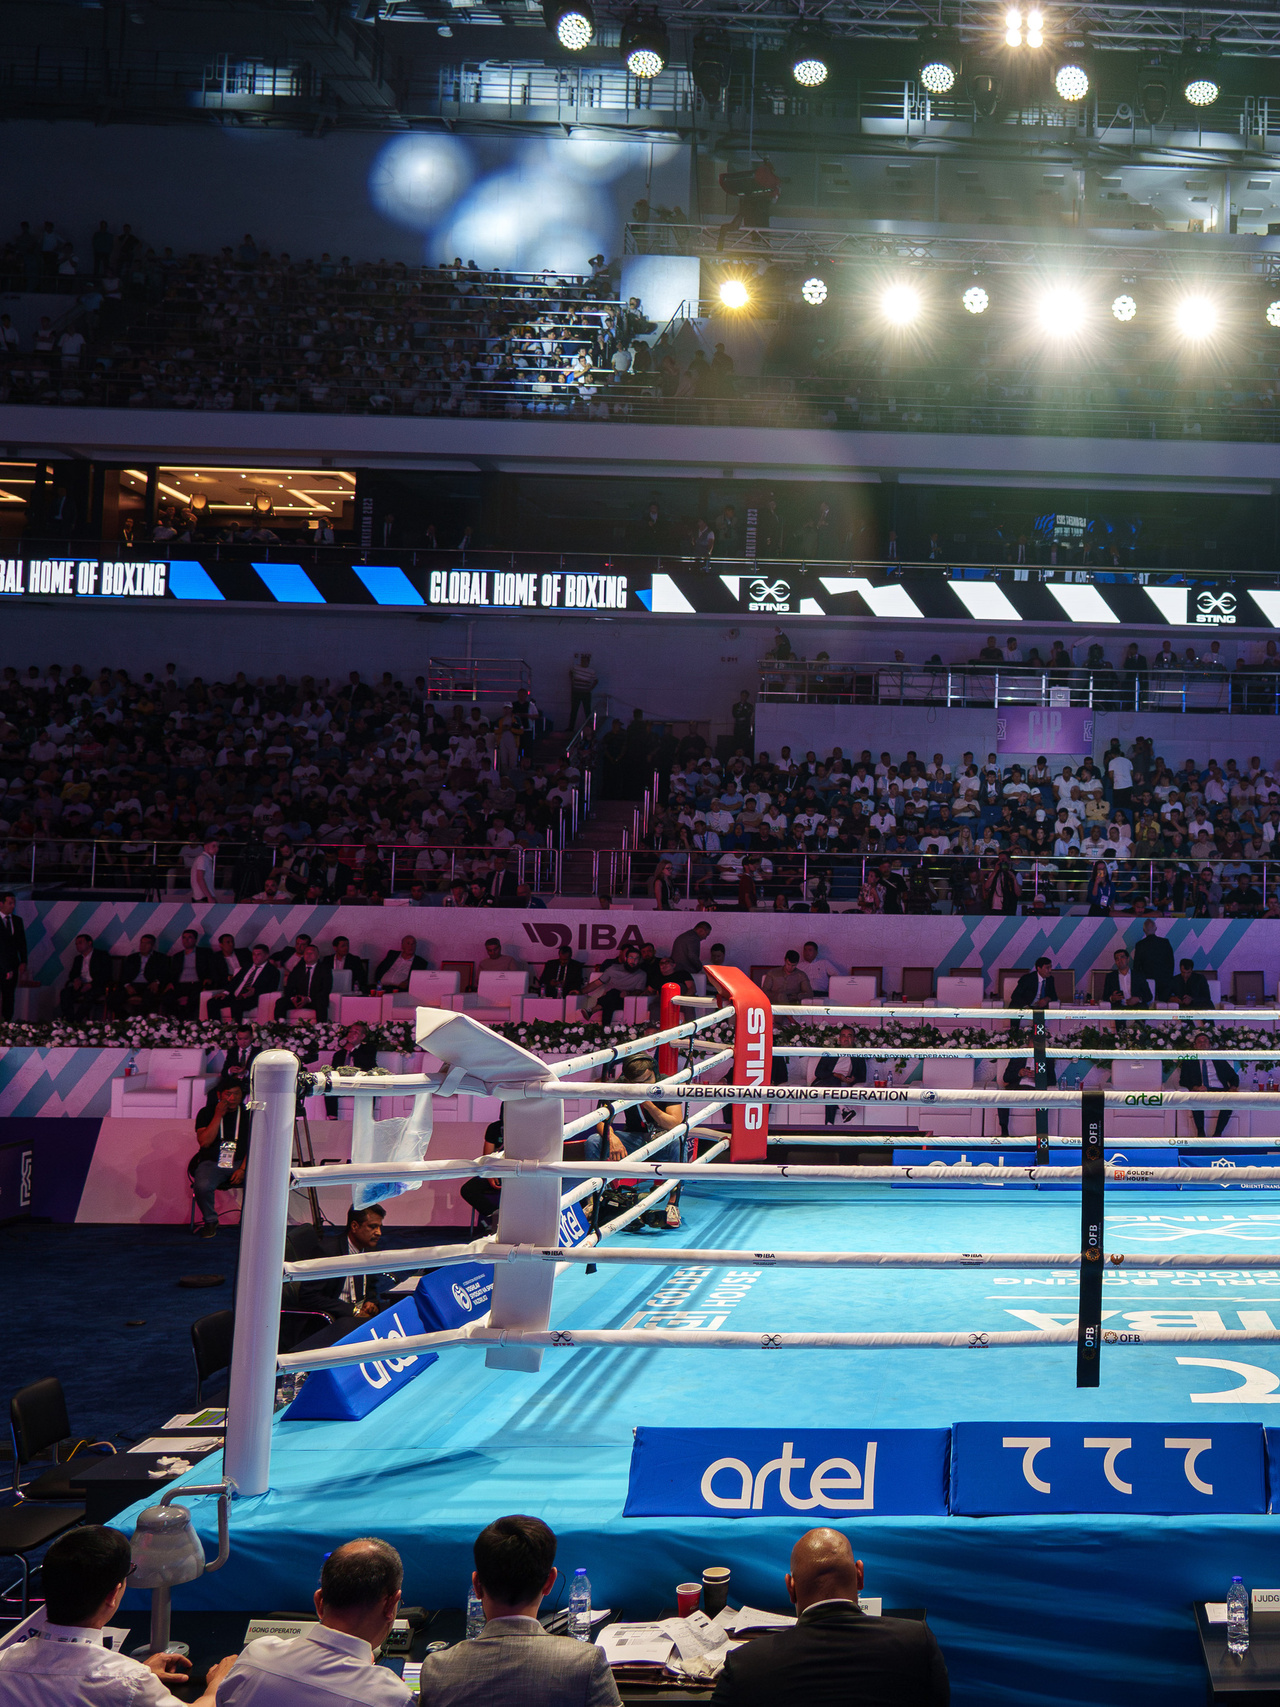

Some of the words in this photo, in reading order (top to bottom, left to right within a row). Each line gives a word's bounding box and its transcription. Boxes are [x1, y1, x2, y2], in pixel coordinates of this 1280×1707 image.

[29, 561, 74, 594] HOME
[77, 561, 98, 594] OF
[101, 562, 166, 596] BOXING
[430, 571, 490, 604] GLOBAL
[493, 573, 538, 606] HOME
[541, 574, 562, 607] OF
[565, 575, 628, 609] BOXING
[748, 603, 790, 612] STING
[1195, 615, 1237, 624] STING
[1028, 710, 1062, 750] CIP
[578, 923, 646, 950] IBA
[677, 1087, 763, 1099] UZBEKISTAN
[766, 1088, 819, 1100] BOXING
[823, 1089, 909, 1102] FEDERATION
[1124, 1092, 1163, 1107] artel
[1089, 1122, 1098, 1144] OFB
[1088, 1224, 1098, 1246] OFB
[701, 1270, 763, 1308] HOUSE
[1085, 1326, 1095, 1348] OFB
[1119, 1333, 1141, 1343] OFB
[700, 1441, 878, 1511] artel
[270, 1627, 301, 1635] OPERATOR
